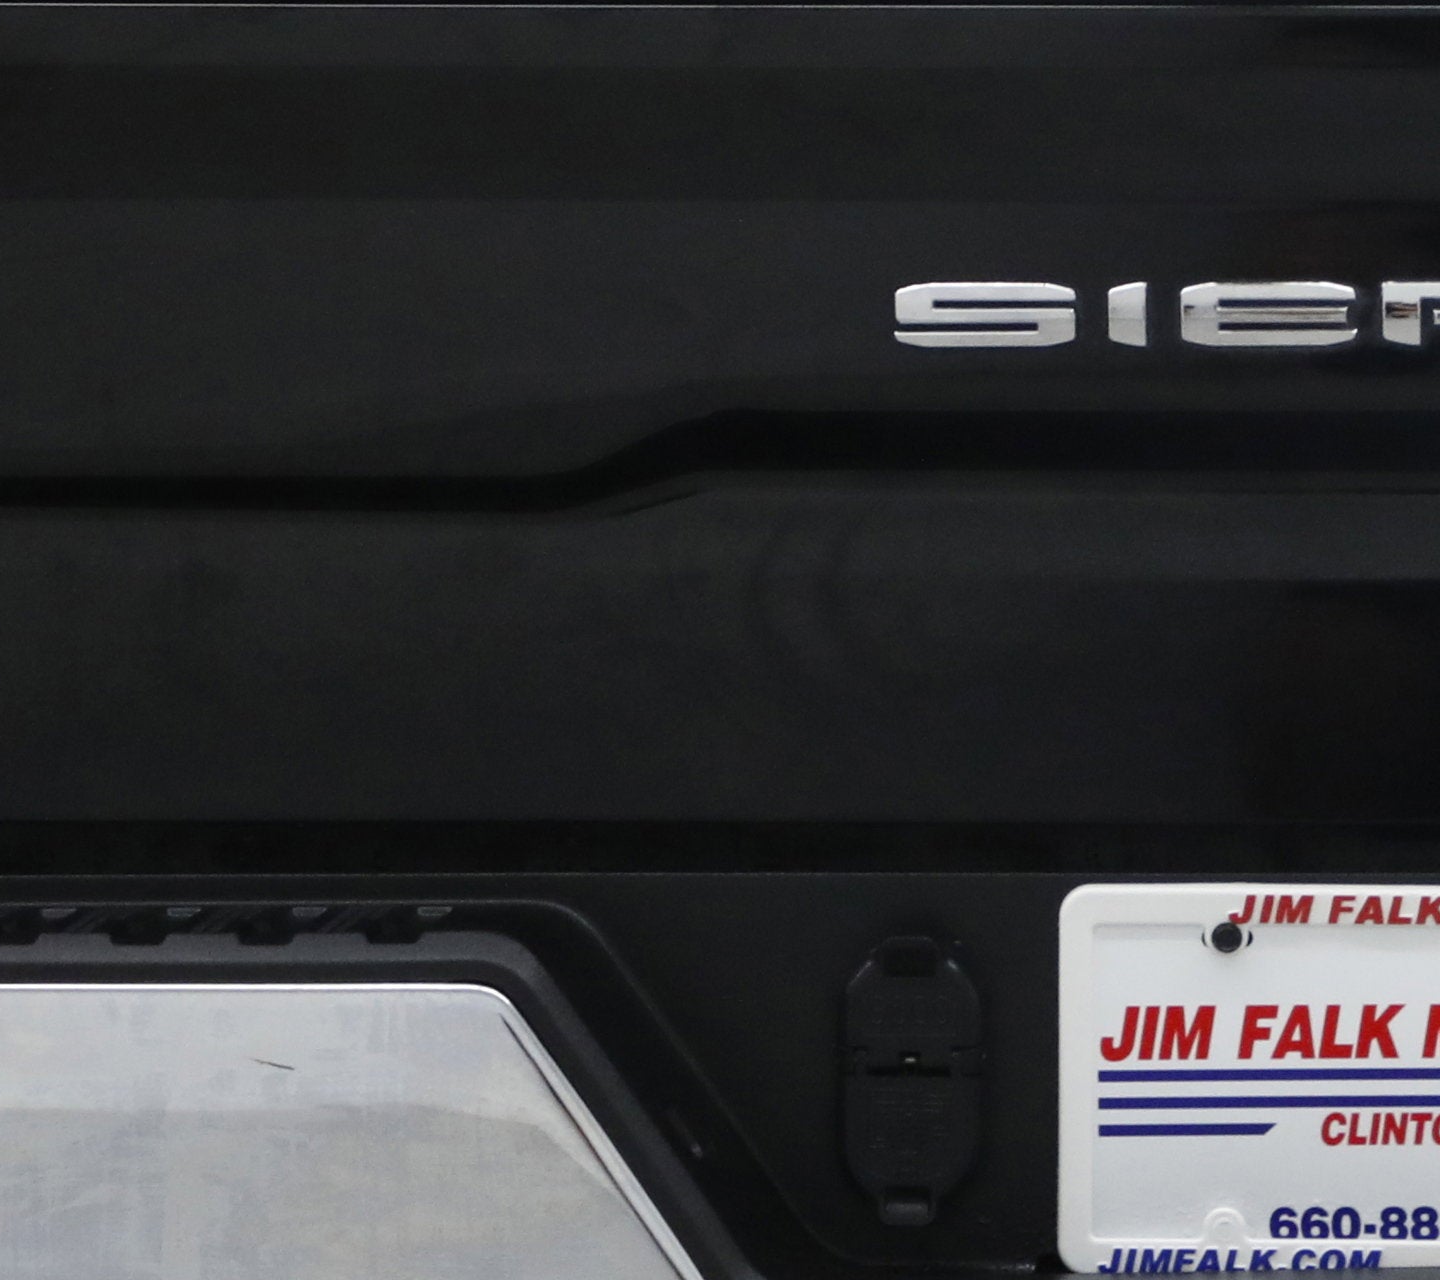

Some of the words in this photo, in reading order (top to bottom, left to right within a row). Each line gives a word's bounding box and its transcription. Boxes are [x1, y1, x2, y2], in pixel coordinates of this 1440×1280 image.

[1228, 894, 1315, 926] JIM
[1100, 1006, 1217, 1062] JIM
[1237, 1004, 1406, 1061] FALK
